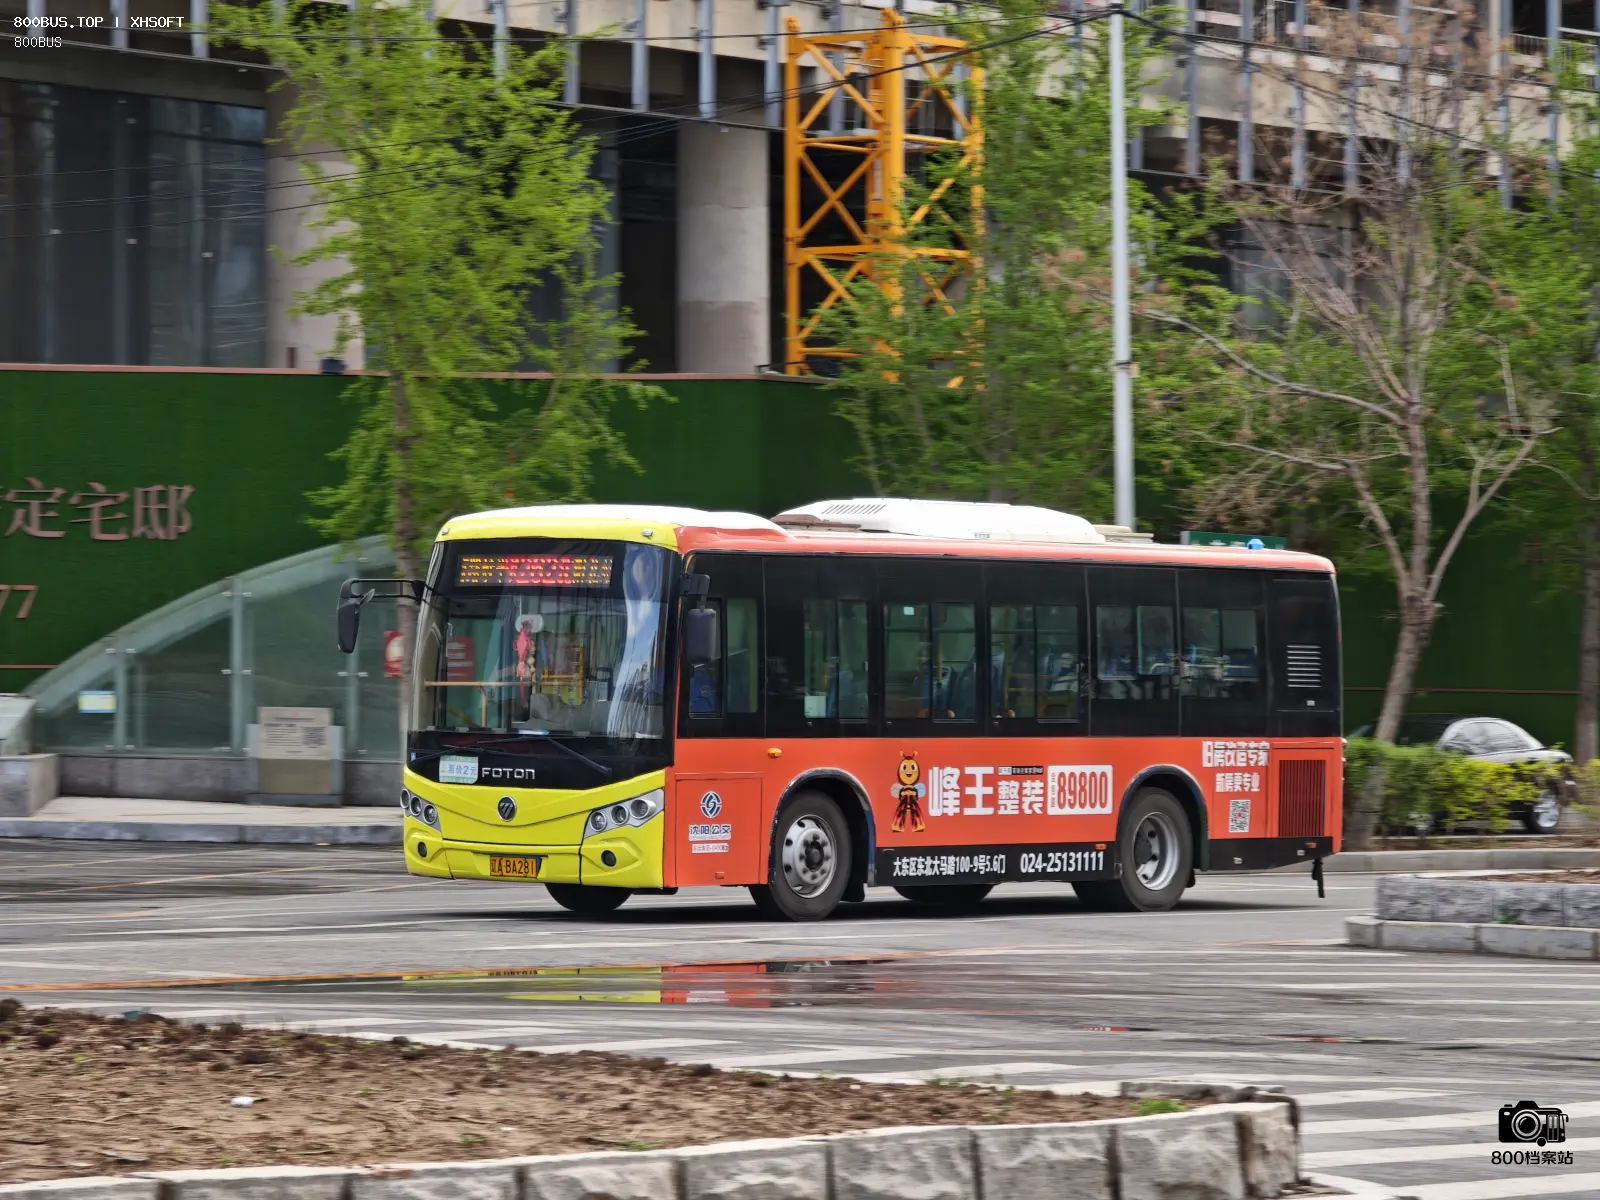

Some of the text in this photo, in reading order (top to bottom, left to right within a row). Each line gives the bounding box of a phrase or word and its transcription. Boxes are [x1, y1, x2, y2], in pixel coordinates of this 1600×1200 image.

[0, 476, 196, 541] 定宅邸
[481, 767, 536, 780] FOTON
[928, 766, 995, 817] 峰王
[997, 779, 1045, 815] 整装
[1057, 771, 1108, 810] 89800
[1020, 851, 1104, 873] 024-25131111
